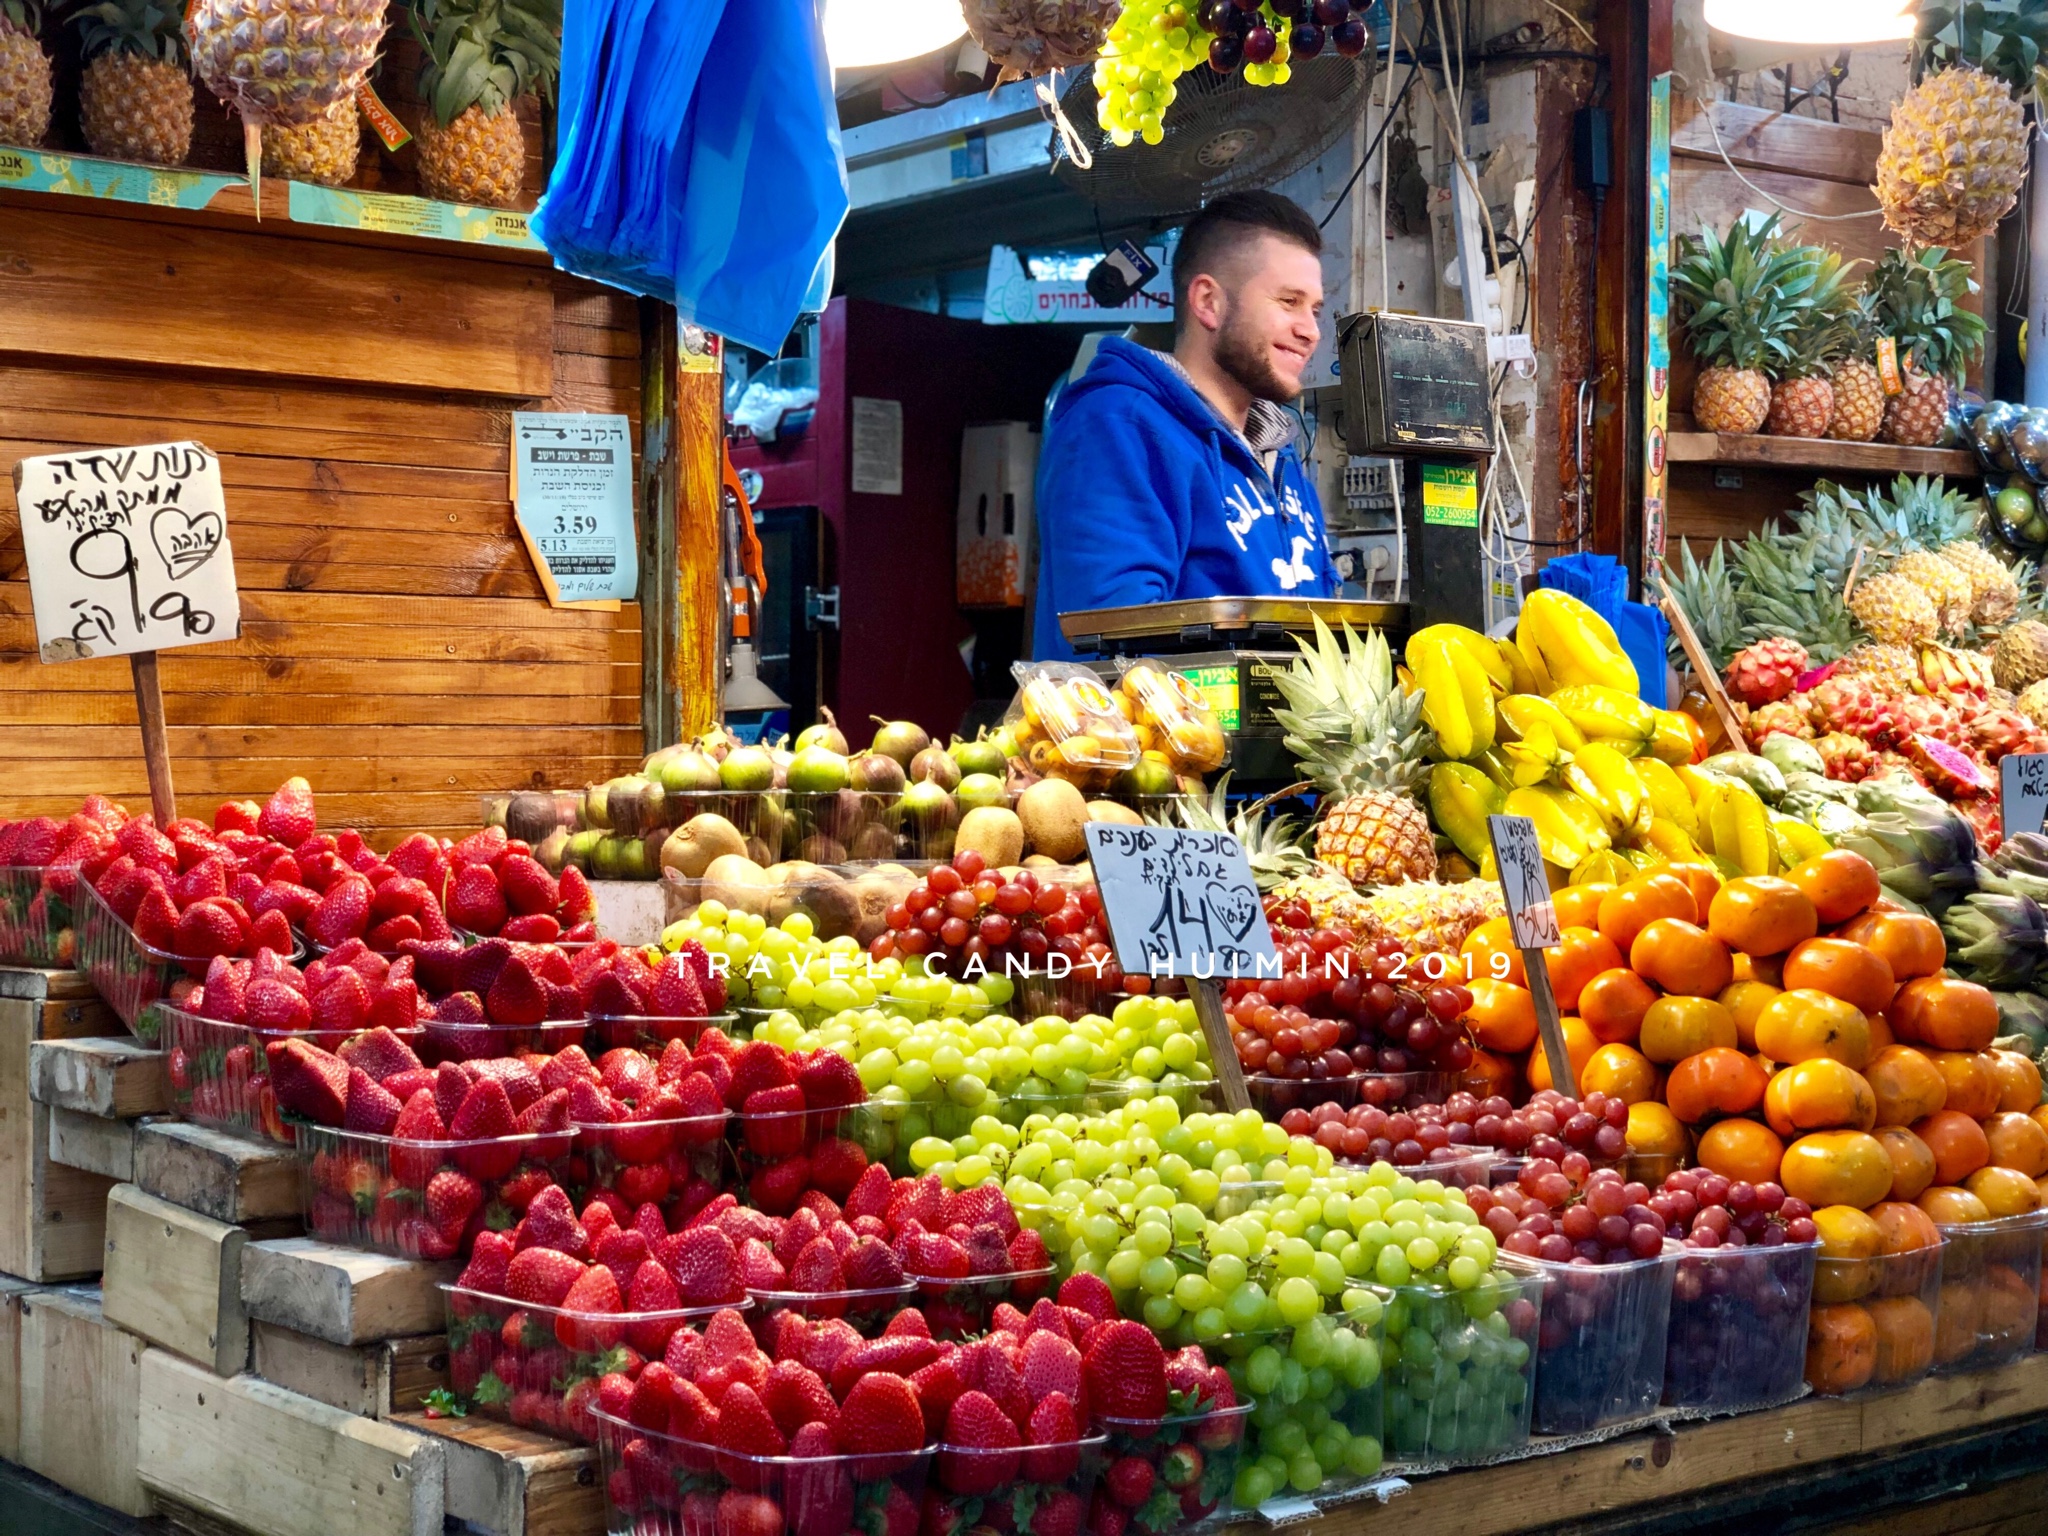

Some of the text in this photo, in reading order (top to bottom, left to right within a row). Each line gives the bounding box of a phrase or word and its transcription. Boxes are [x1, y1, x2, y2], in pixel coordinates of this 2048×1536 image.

[378, 119, 398, 141] אחר
[0, 155, 22, 169] אננ
[495, 216, 527, 230] אננדה
[1124, 249, 1142, 268] FIX
[537, 450, 555, 461] וישב
[557, 451, 580, 461] פרשת
[589, 451, 607, 461] שבת
[47, 446, 207, 485] תות שדה
[533, 465, 614, 479] זמן הדלקת הנרות
[1444, 468, 1477, 485] אבירן
[541, 481, 606, 491] וכניסת השבת
[1425, 505, 1476, 520] 052-2600554
[553, 515, 598, 535] 3.59
[540, 539, 568, 552] 5.13
[69, 528, 143, 634] 9
[577, 578, 594, 592] שלום
[596, 581, 613, 591] שבת
[1199, 668, 1238, 689] אבירן
